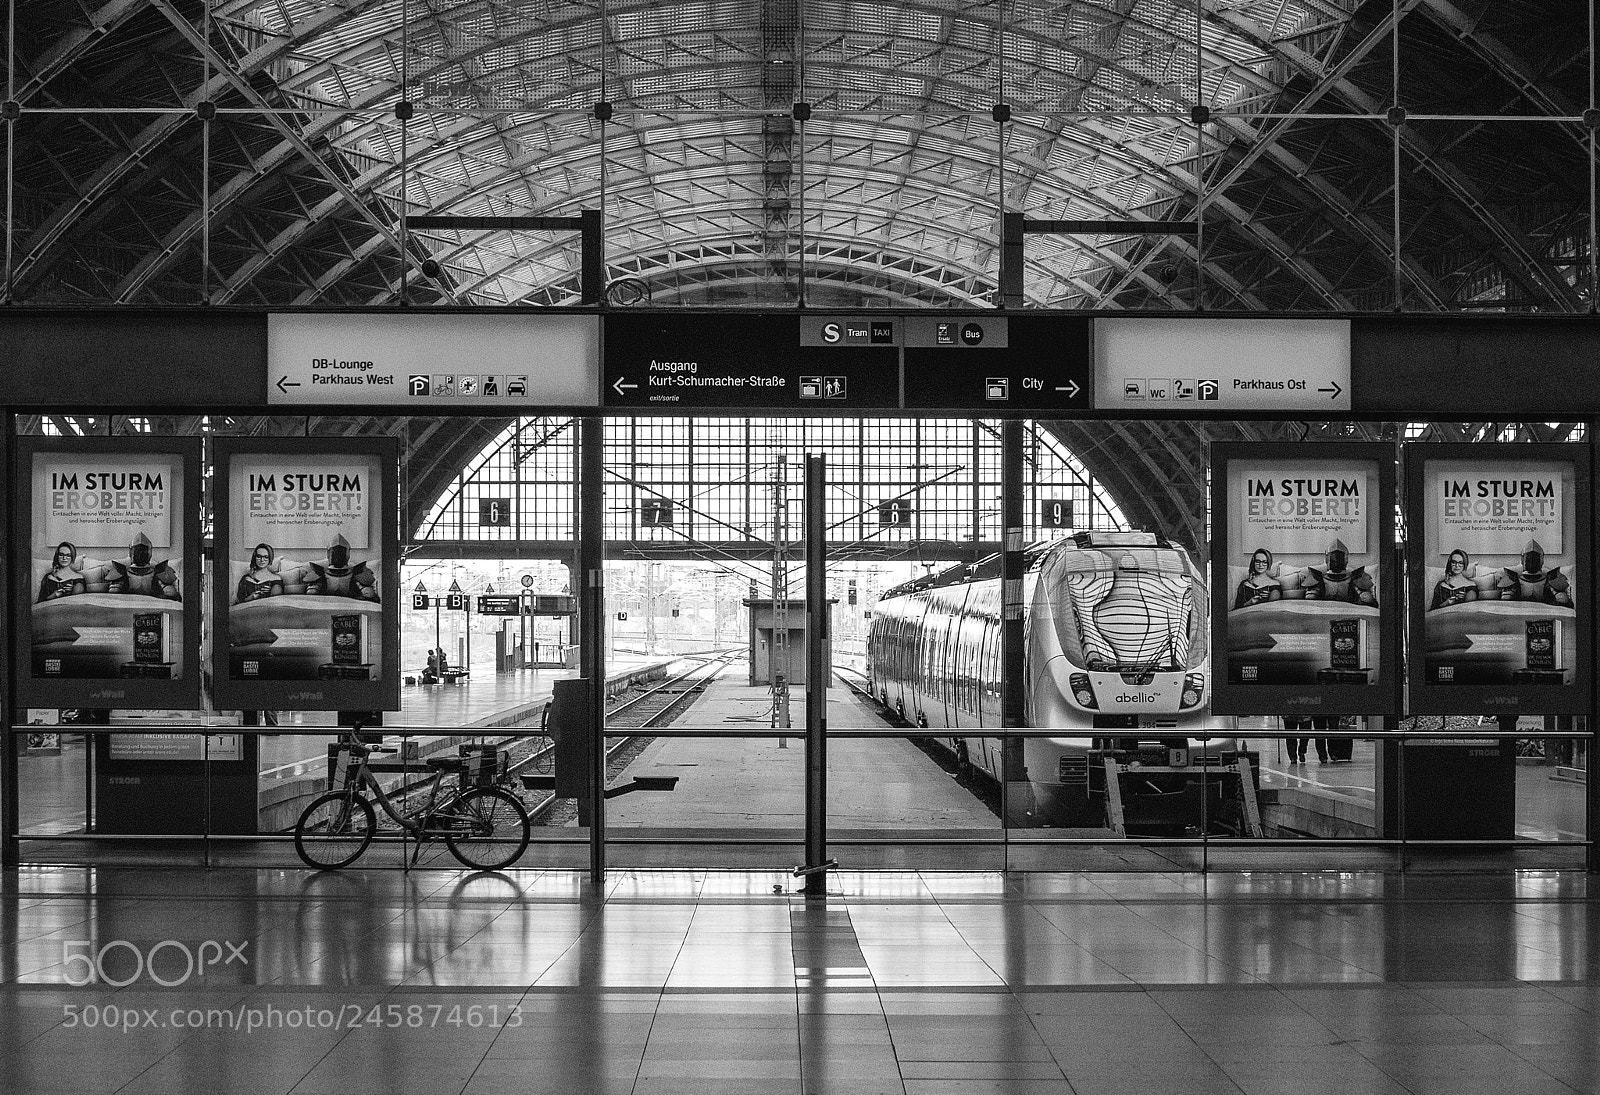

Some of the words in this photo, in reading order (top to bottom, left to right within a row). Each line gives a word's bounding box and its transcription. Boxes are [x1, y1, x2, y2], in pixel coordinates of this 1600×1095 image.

[824, 323, 840, 342] S
[847, 328, 868, 337] Tram
[873, 328, 890, 336] TAXI
[965, 330, 980, 338] Bus
[312, 359, 374, 371] DB-Lounge
[650, 360, 698, 373] Ausgang
[312, 374, 364, 385] Parkhaus
[366, 374, 394, 385] West
[649, 375, 786, 387] Kurt-Schumacher-Straße
[1022, 377, 1044, 391] City
[1233, 379, 1284, 390] Parkhaus
[1287, 379, 1307, 390] Ost
[1150, 389, 1165, 398] WC
[52, 472, 79, 490] IM
[85, 472, 163, 490] STURM
[250, 474, 276, 491] IM
[283, 474, 361, 491] STURM
[1248, 479, 1274, 496] IM
[1281, 479, 1359, 496] STURM
[1444, 480, 1470, 497] IM
[1477, 480, 1554, 497] STURM
[52, 491, 164, 510] EROBERT!
[250, 493, 362, 510] EROBERT!
[1248, 498, 1359, 515] EROBERT!
[1444, 499, 1555, 516] EROBERT!
[490, 501, 498, 523] 6
[652, 502, 661, 524] 7
[891, 502, 899, 524] 8
[1053, 503, 1062, 525] 9
[414, 595, 424, 606] B
[452, 595, 461, 606] B
[620, 612, 627, 620] D
[1115, 692, 1155, 703] abellio
[408, 744, 413, 755] 7
